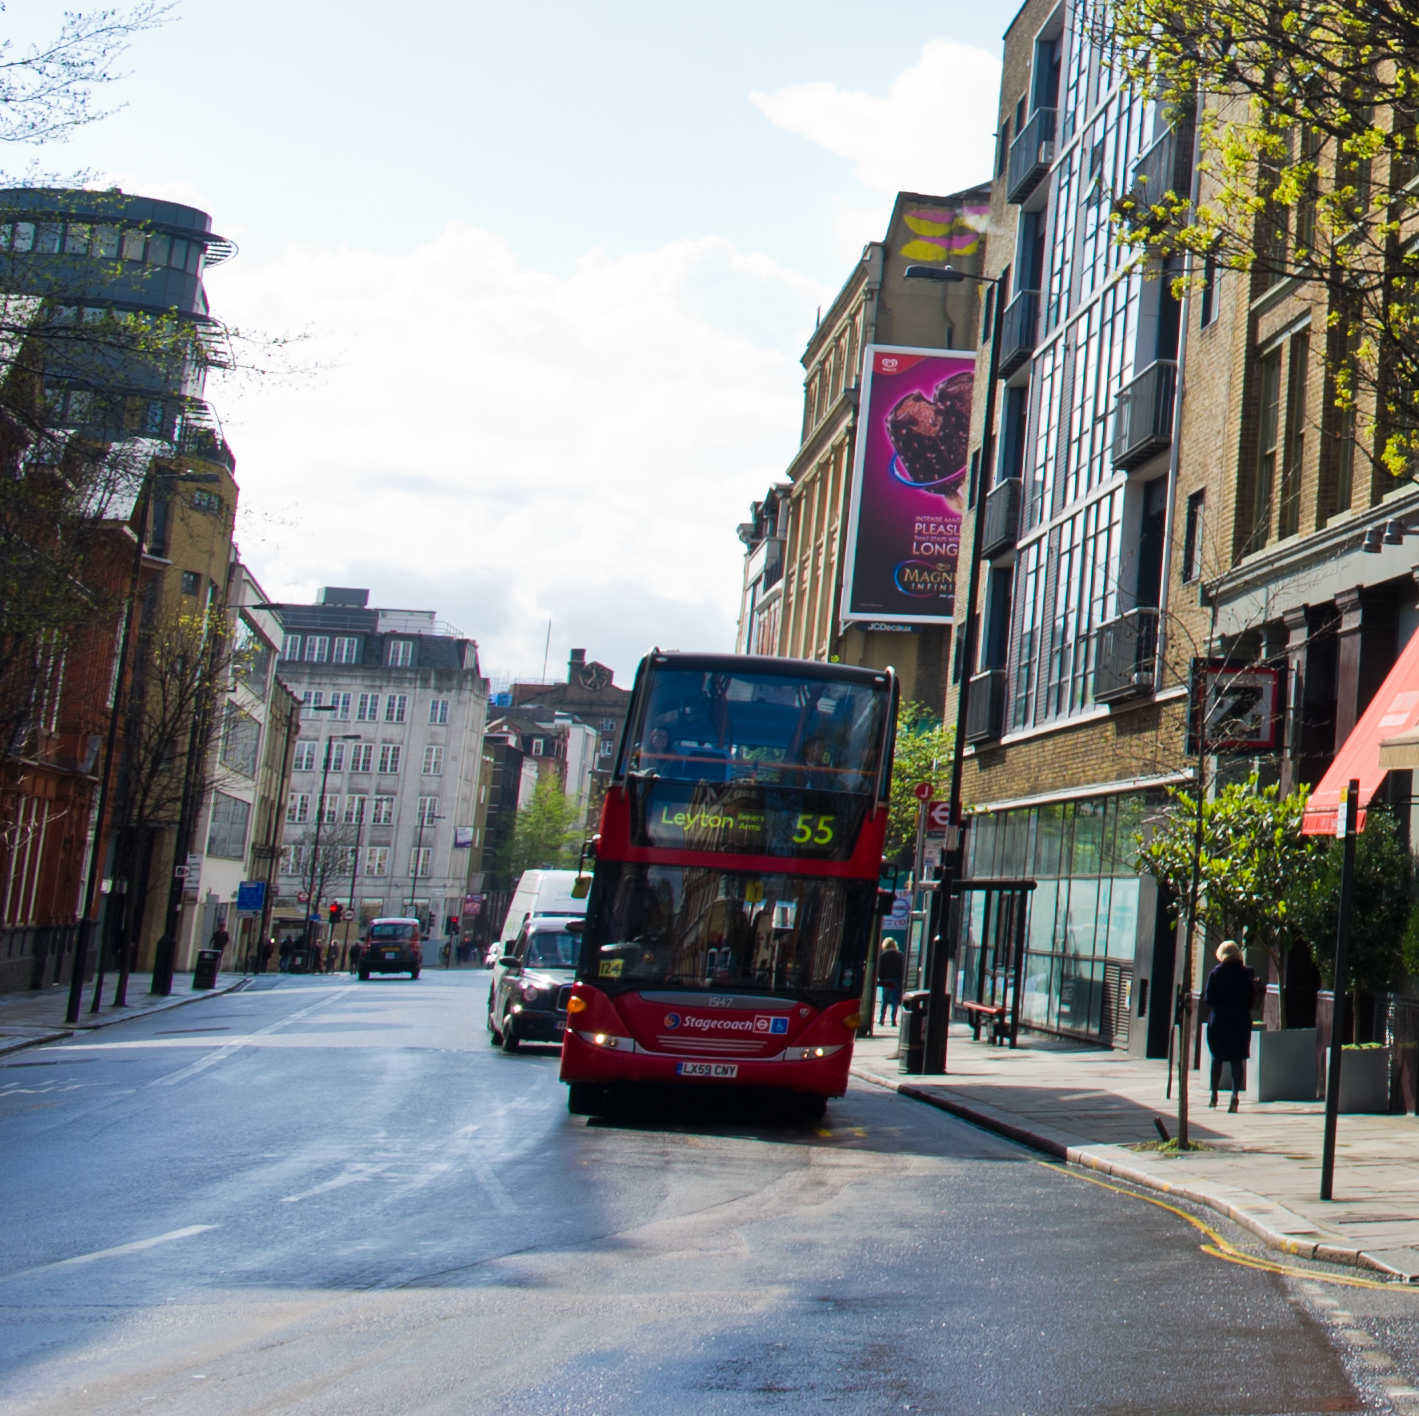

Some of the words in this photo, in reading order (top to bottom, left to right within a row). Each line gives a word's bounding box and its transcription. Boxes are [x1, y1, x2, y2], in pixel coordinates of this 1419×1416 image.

[914, 522, 961, 536] PLEASU
[912, 542, 958, 556] LONG
[904, 568, 957, 583] MAGN
[911, 583, 954, 592] INFINI
[867, 622, 912, 632] JCDecaux
[1208, 686, 1264, 739] Z
[920, 785, 929, 799] J
[661, 806, 735, 831] Leyton
[737, 812, 765, 822] Bakers
[792, 814, 836, 845] 55
[737, 822, 762, 832] Arms
[708, 996, 733, 1008] 15147
[683, 1015, 753, 1031] Stagecoach
[683, 1063, 713, 1075] LX59
[714, 1065, 737, 1076] CNY
